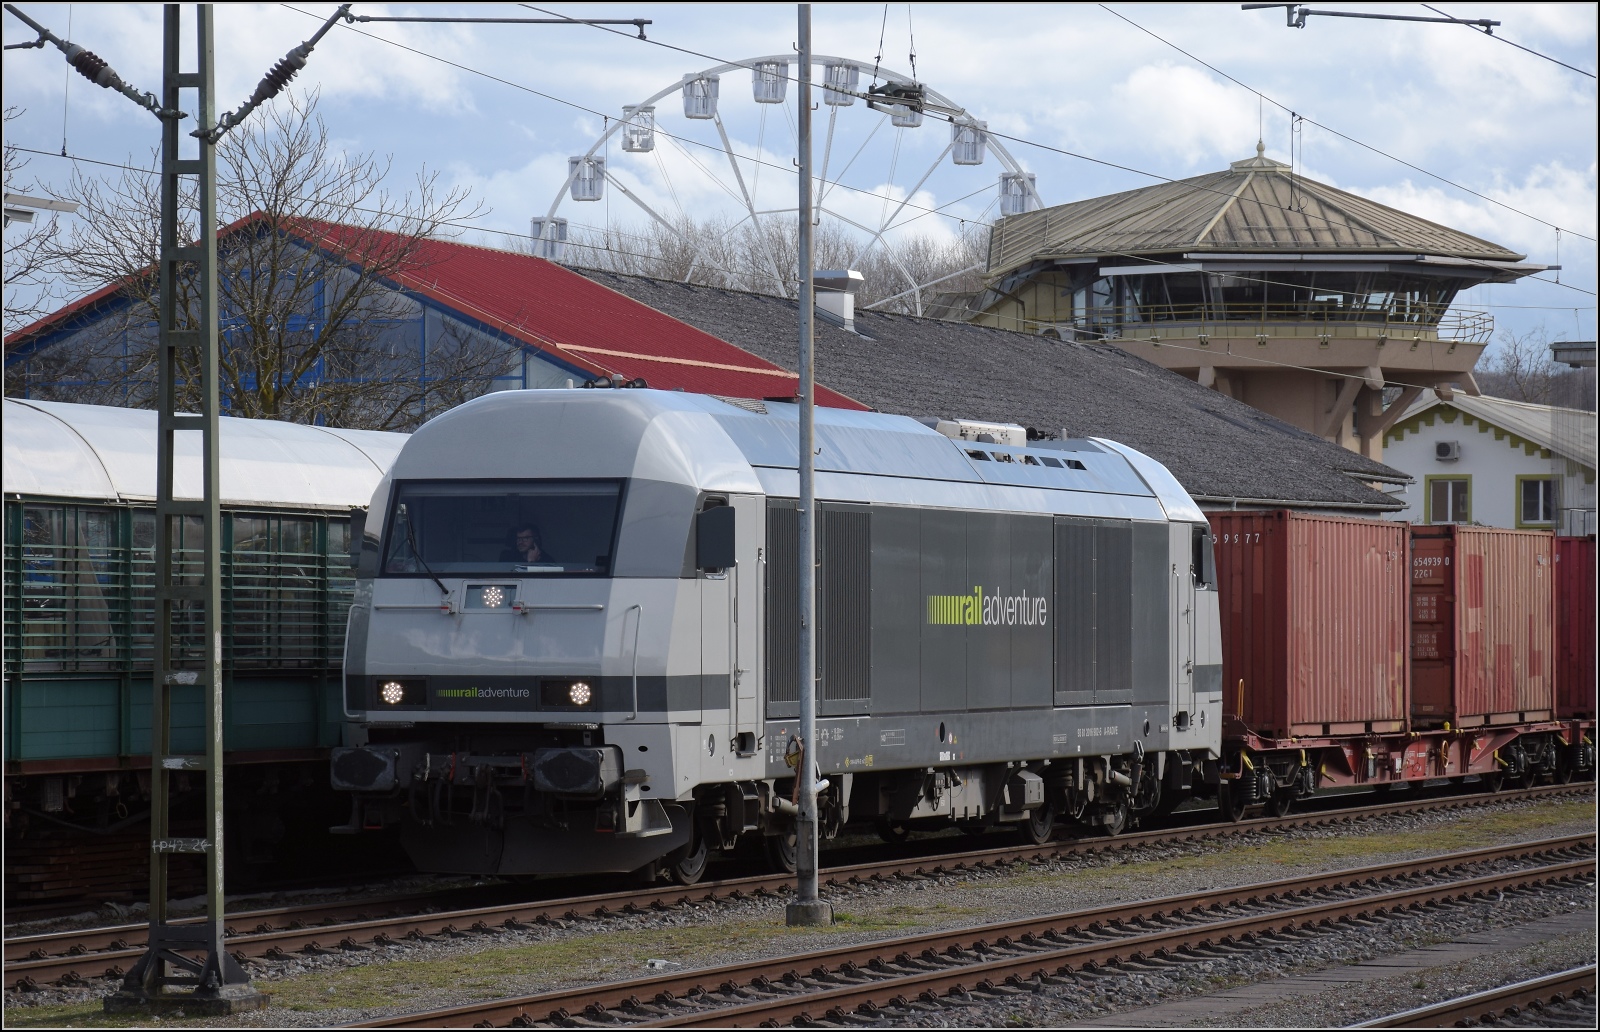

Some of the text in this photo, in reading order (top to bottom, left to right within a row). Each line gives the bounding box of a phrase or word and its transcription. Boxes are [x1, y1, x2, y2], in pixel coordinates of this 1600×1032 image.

[1413, 557, 1442, 567] 654939
[1414, 569, 1432, 579] 22G1
[958, 585, 1047, 626] railadventure
[459, 687, 530, 698] railadventure
